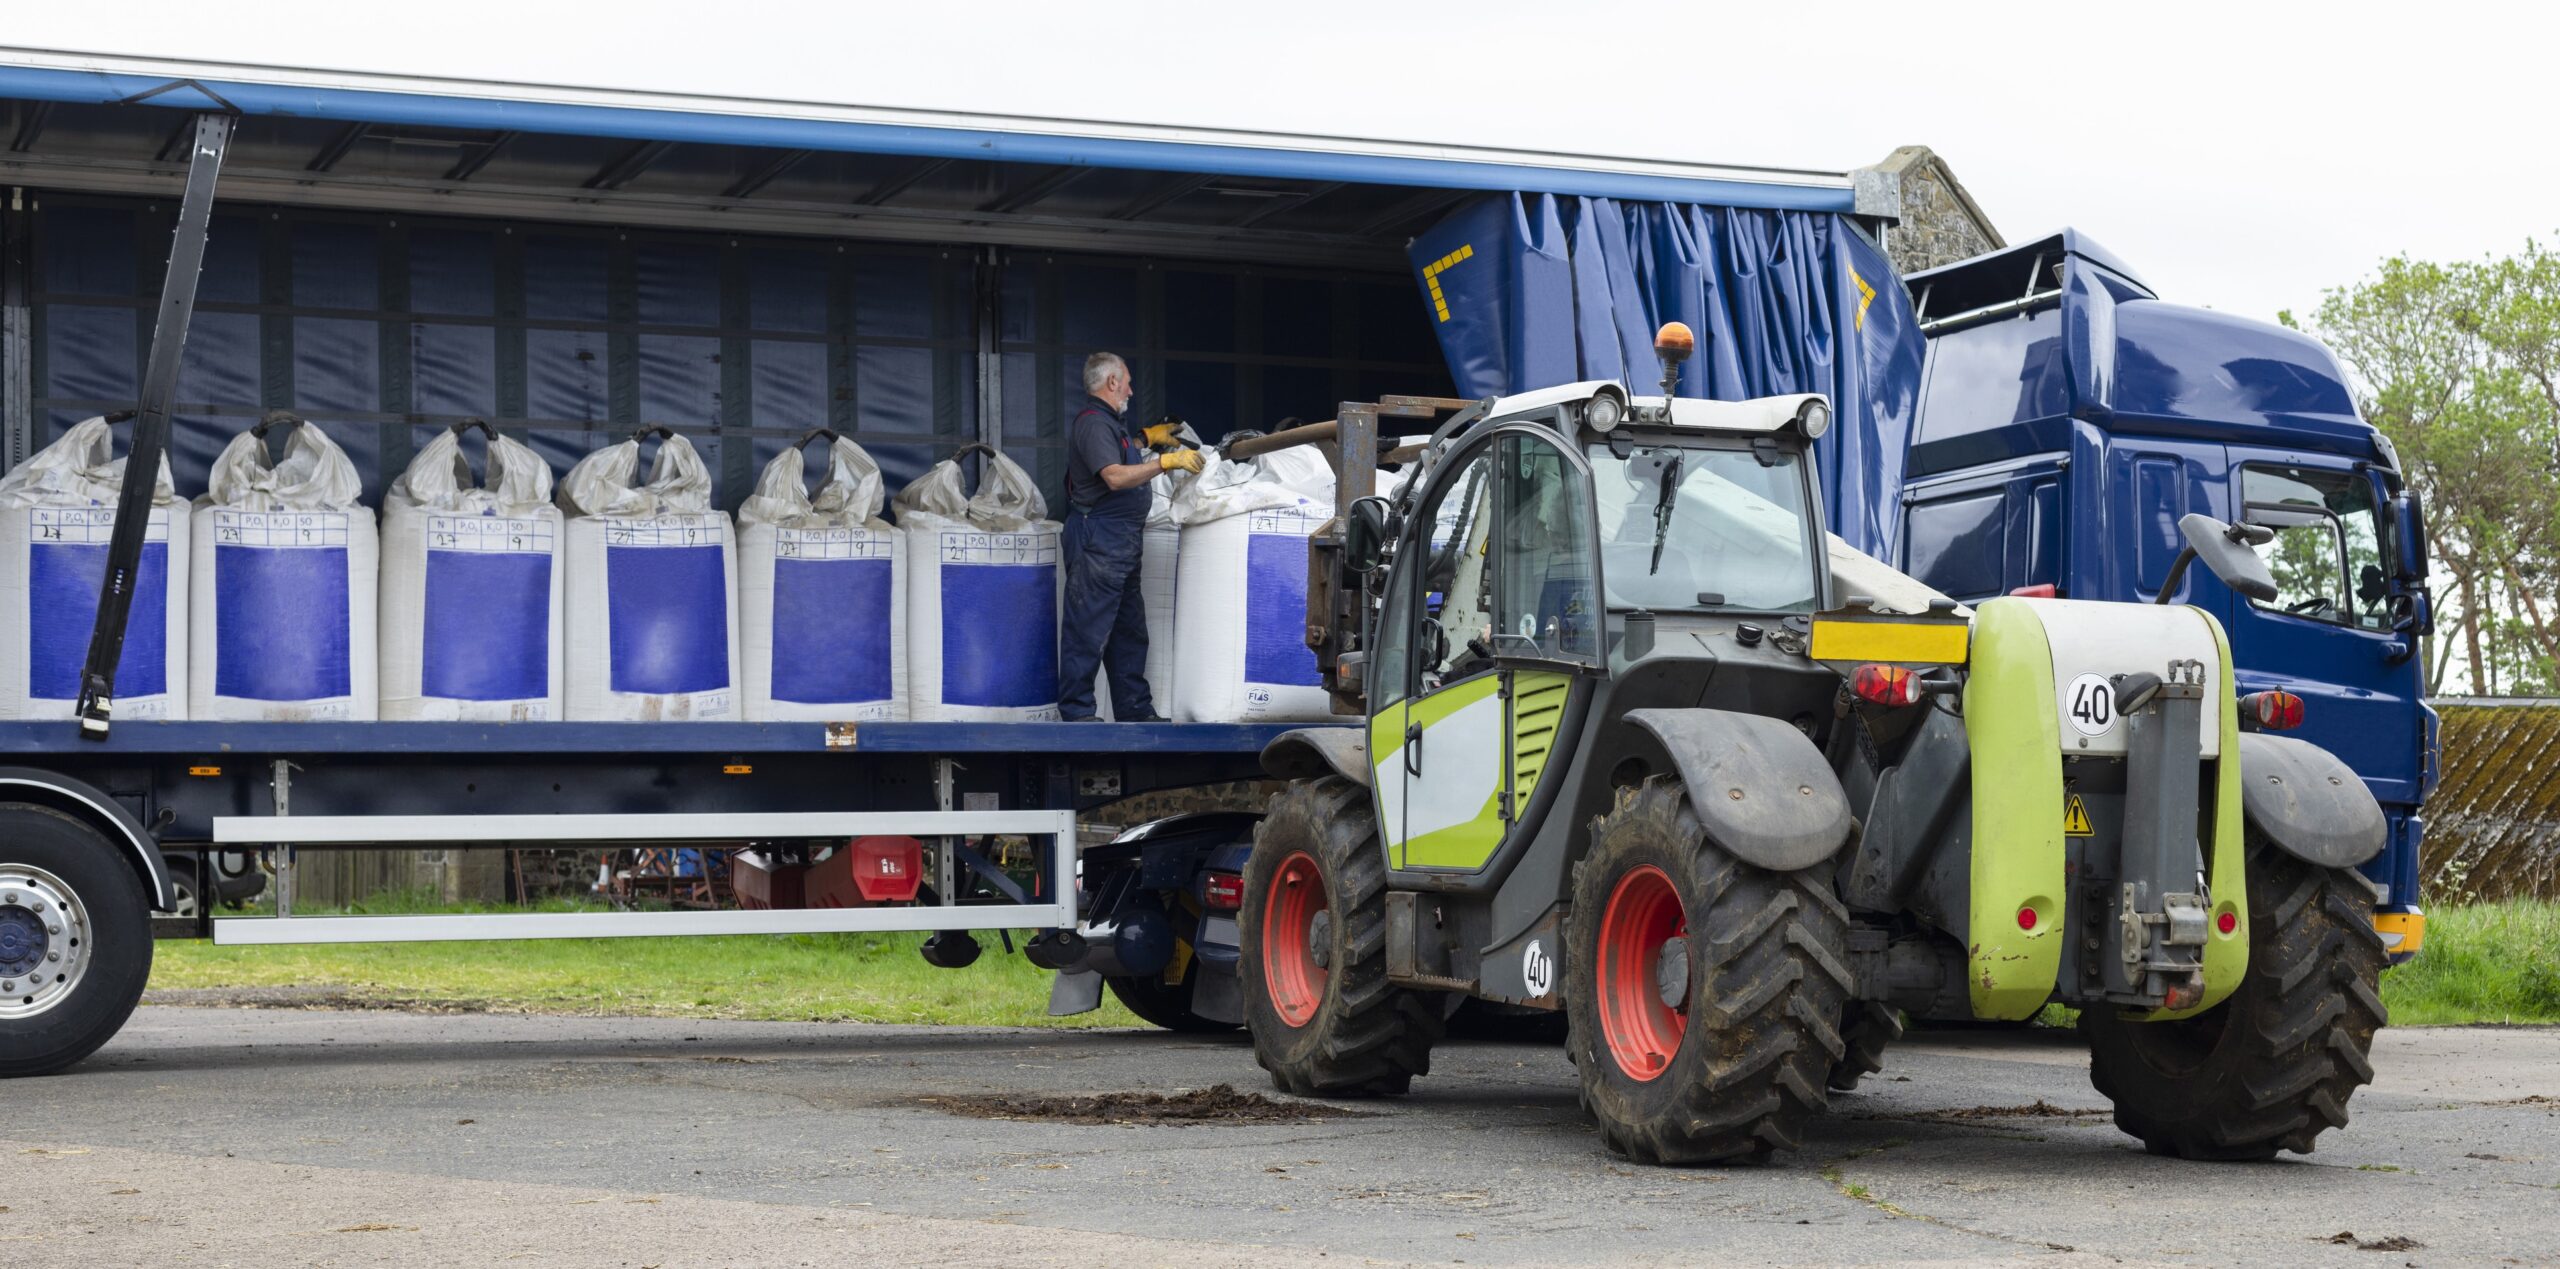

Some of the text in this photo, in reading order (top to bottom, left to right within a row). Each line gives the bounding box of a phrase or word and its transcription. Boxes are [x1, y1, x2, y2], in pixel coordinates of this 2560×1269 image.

[41, 512, 48, 521] N
[223, 514, 230, 523] N
[437, 520, 444, 529] N
[511, 523, 523, 531] SO
[1257, 517, 1271, 530] 27
[223, 529, 310, 541] 27 9
[688, 528, 695, 548] 9
[854, 531, 865, 539] SO
[949, 536, 956, 545] N
[1017, 537, 1029, 545] SO
[437, 534, 522, 550] 27 9
[781, 541, 864, 556] 27 9
[950, 545, 964, 560] 27
[2072, 683, 2110, 725] 40
[1528, 951, 1547, 988] 40
